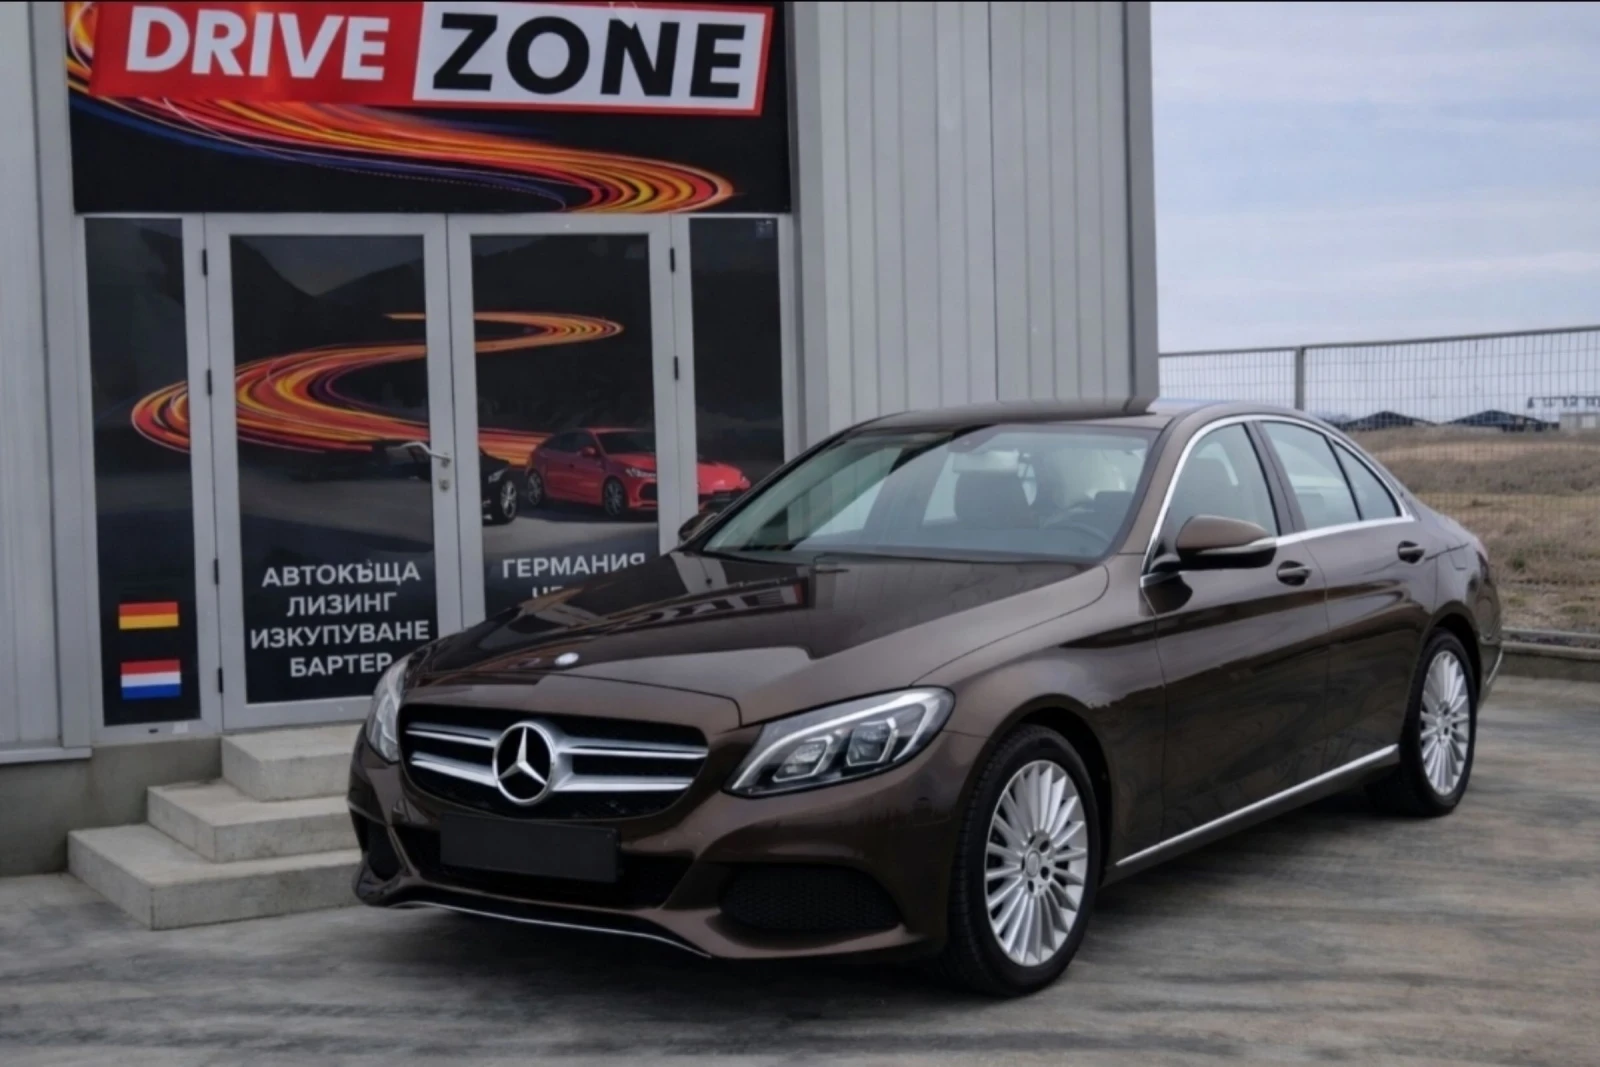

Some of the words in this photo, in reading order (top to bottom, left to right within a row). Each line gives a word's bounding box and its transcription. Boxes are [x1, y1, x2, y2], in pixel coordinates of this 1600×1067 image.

[126, 6, 389, 80] DRIVE
[433, 13, 745, 98] ZONE
[261, 561, 421, 588] АВТОКЪЩА
[286, 591, 397, 618] ЛИЗИНГ
[250, 620, 430, 649] ИЗКУПУВАНЕ
[290, 652, 393, 678] БАРТЕР
